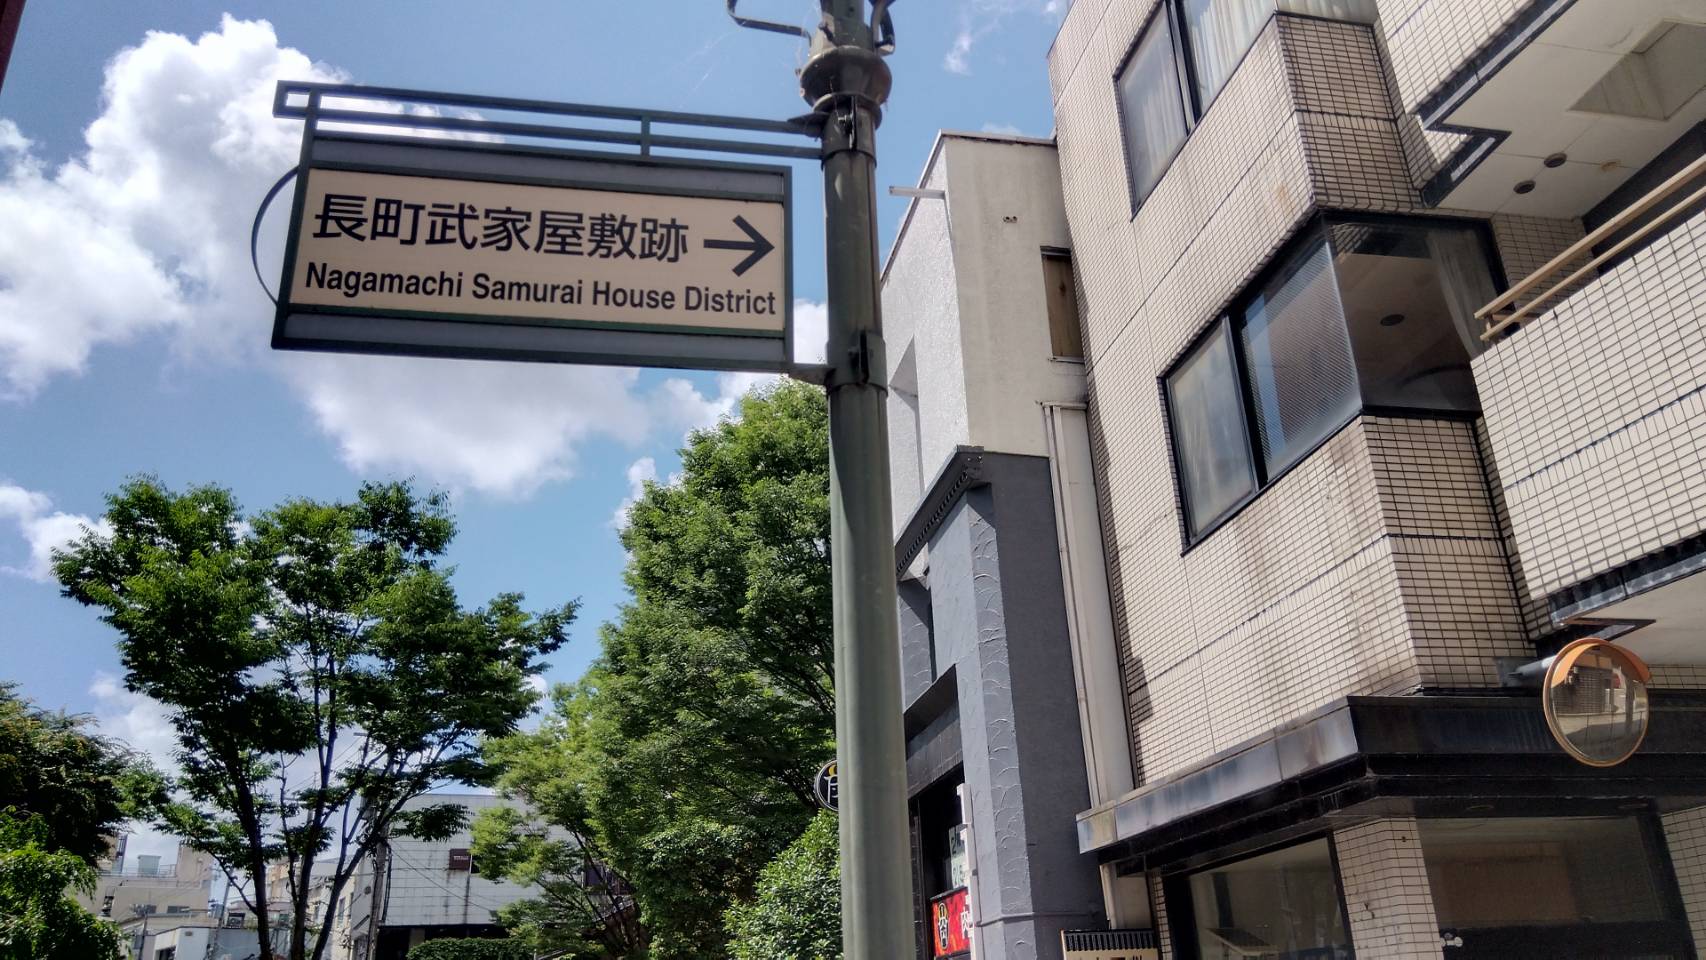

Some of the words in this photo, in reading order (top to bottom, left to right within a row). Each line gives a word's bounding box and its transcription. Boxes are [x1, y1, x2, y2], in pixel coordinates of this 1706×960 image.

[312, 193, 690, 264] 長町武家屋敷跡
[305, 261, 464, 298] Nagamachi
[471, 272, 583, 305] Samurai
[592, 280, 676, 310] House
[684, 285, 776, 315] District
